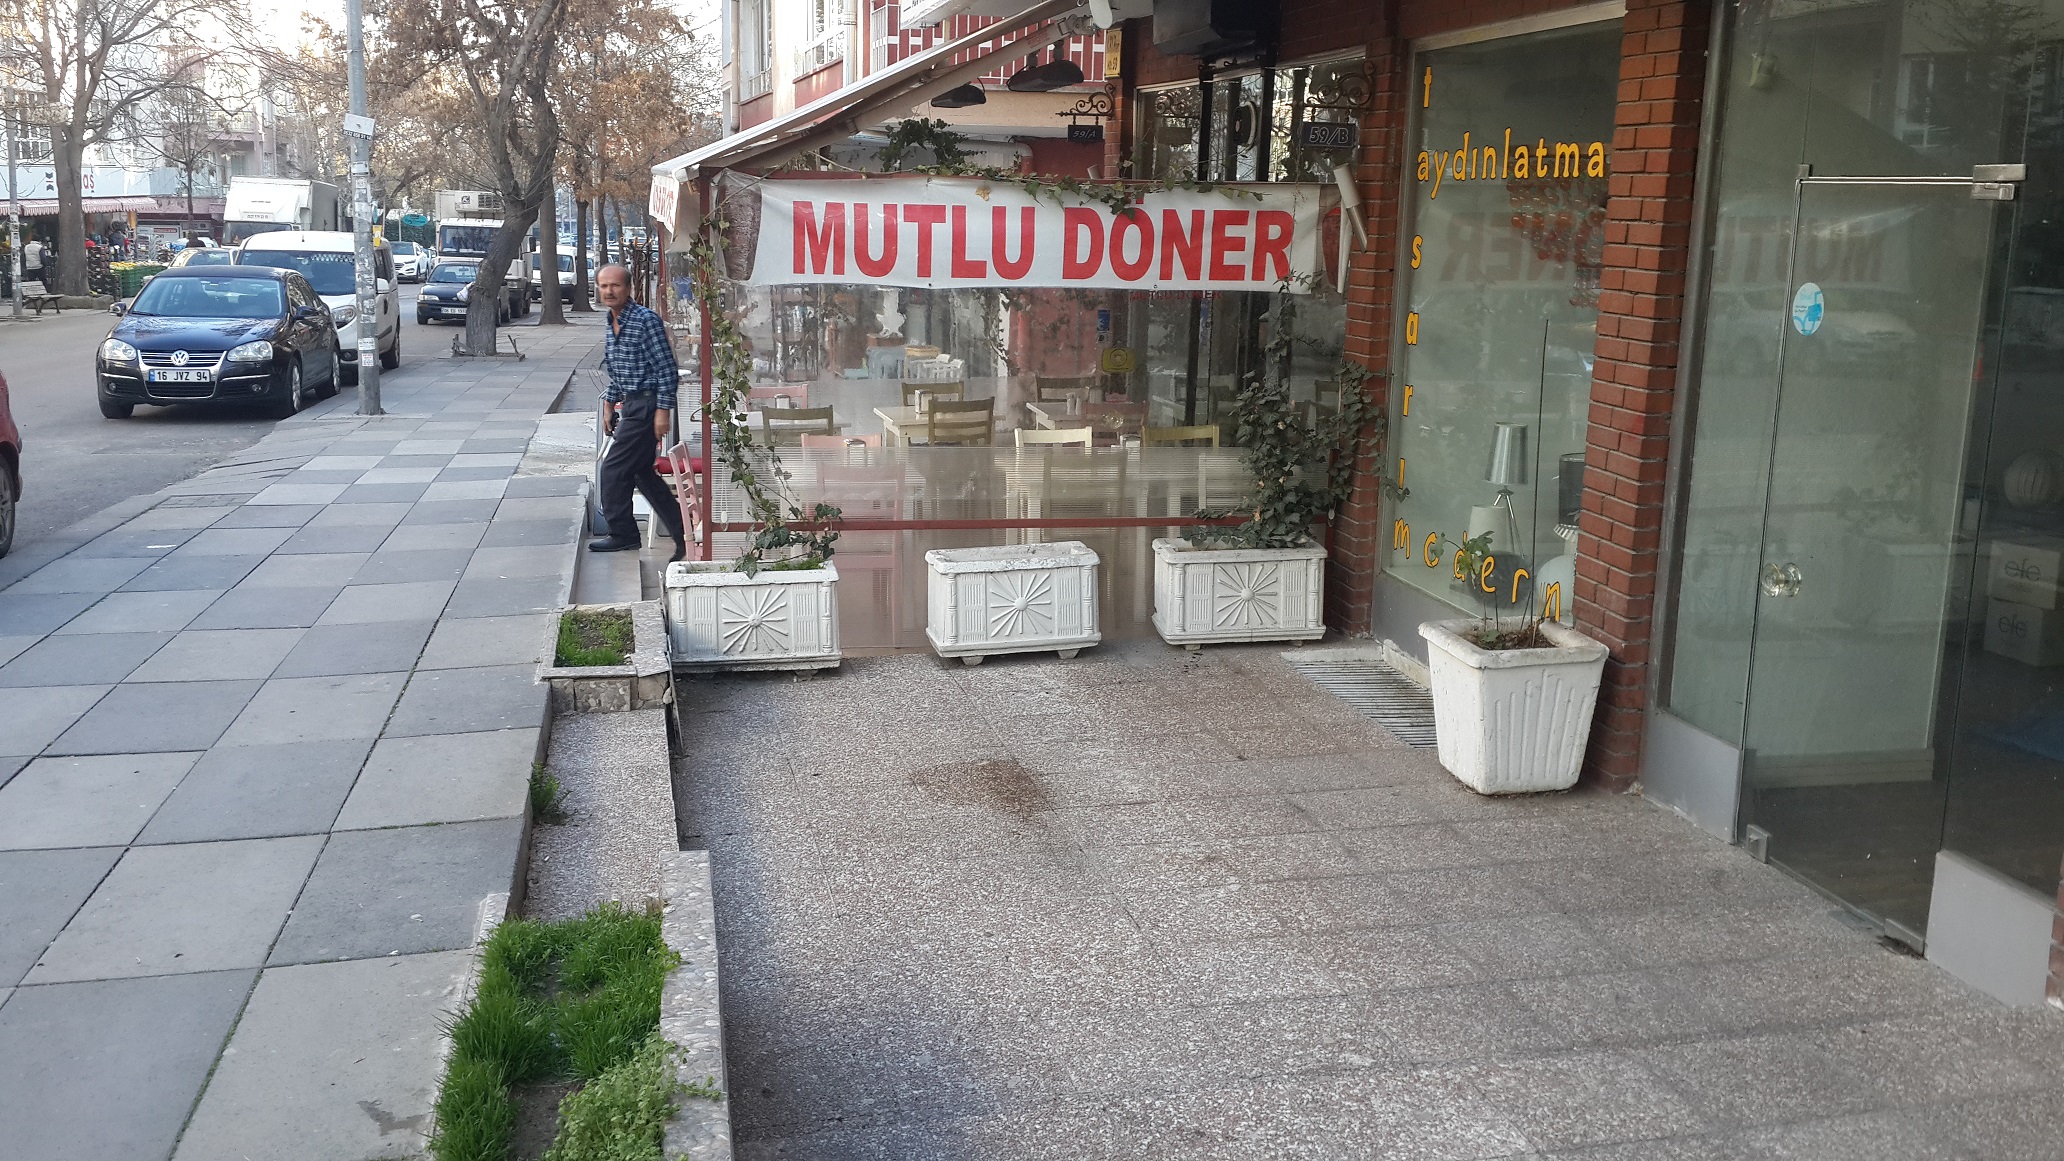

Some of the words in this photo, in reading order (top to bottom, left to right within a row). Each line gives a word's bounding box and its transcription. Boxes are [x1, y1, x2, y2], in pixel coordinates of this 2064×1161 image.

[1072, 128, 1097, 139] 59/A
[1308, 126, 1349, 145] 59/B
[1417, 127, 1605, 199] aydınlatma
[793, 200, 1036, 281] MUTLU
[1062, 191, 1295, 282] DÖNER
[157, 371, 168, 381] 16
[173, 371, 190, 381] JVZ
[196, 371, 208, 381] 94
